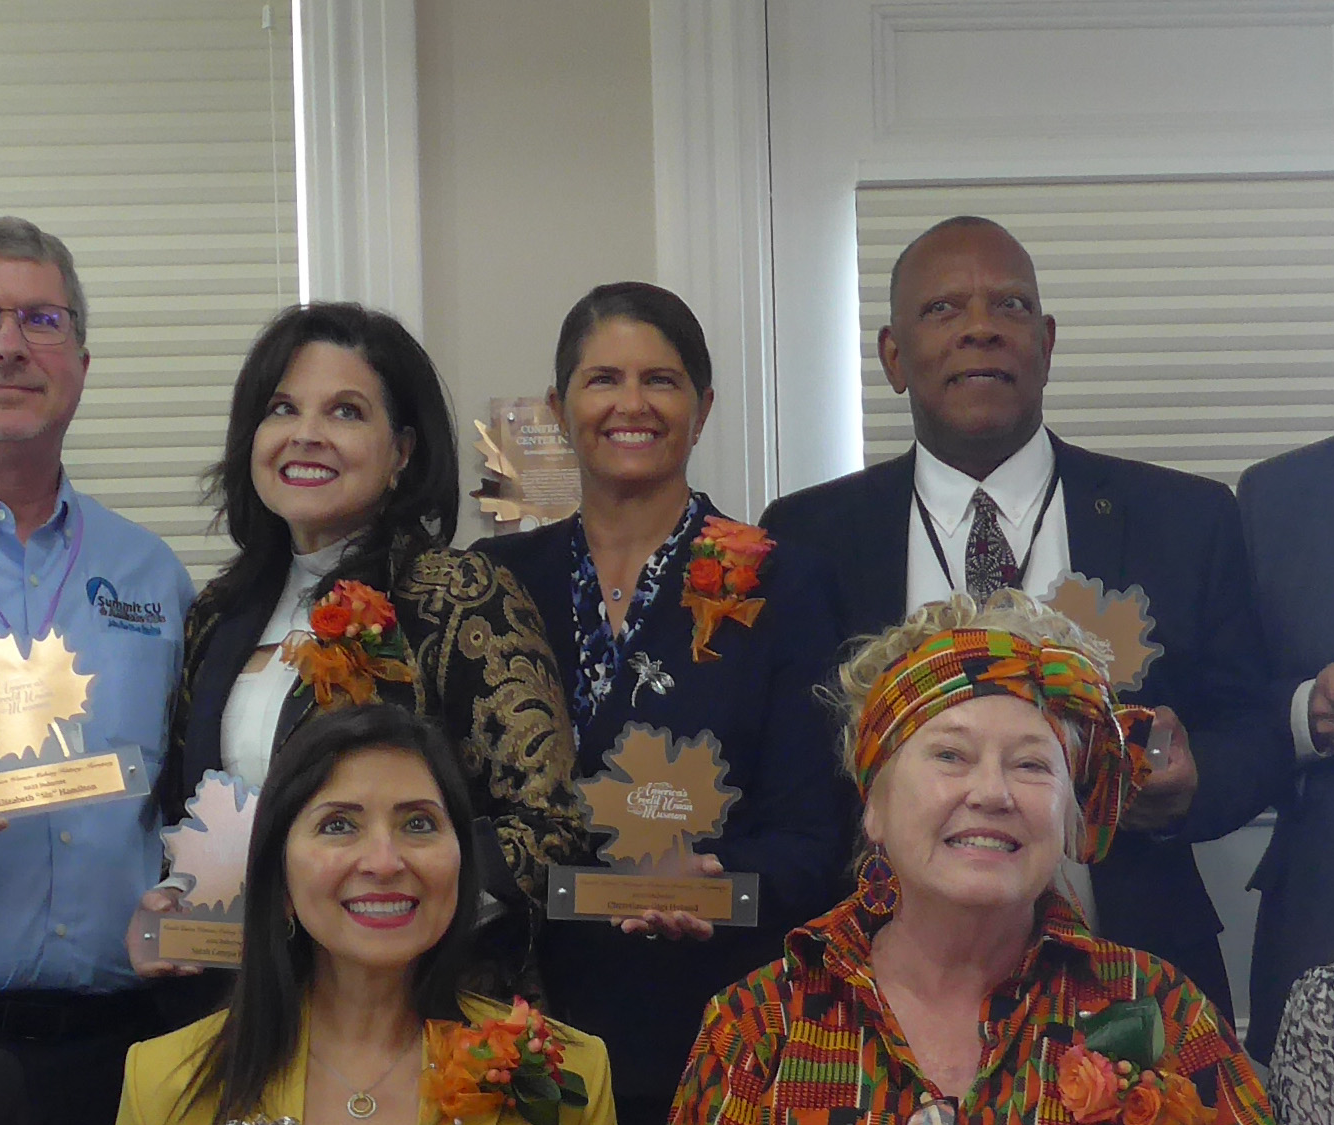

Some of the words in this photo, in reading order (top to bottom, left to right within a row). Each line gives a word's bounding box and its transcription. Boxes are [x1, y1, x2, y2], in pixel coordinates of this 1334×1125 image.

[521, 423, 560, 434] CONFER
[97, 596, 142, 613] Summit
[144, 602, 162, 615] CU
[58, 783, 98, 797] Hamilton
